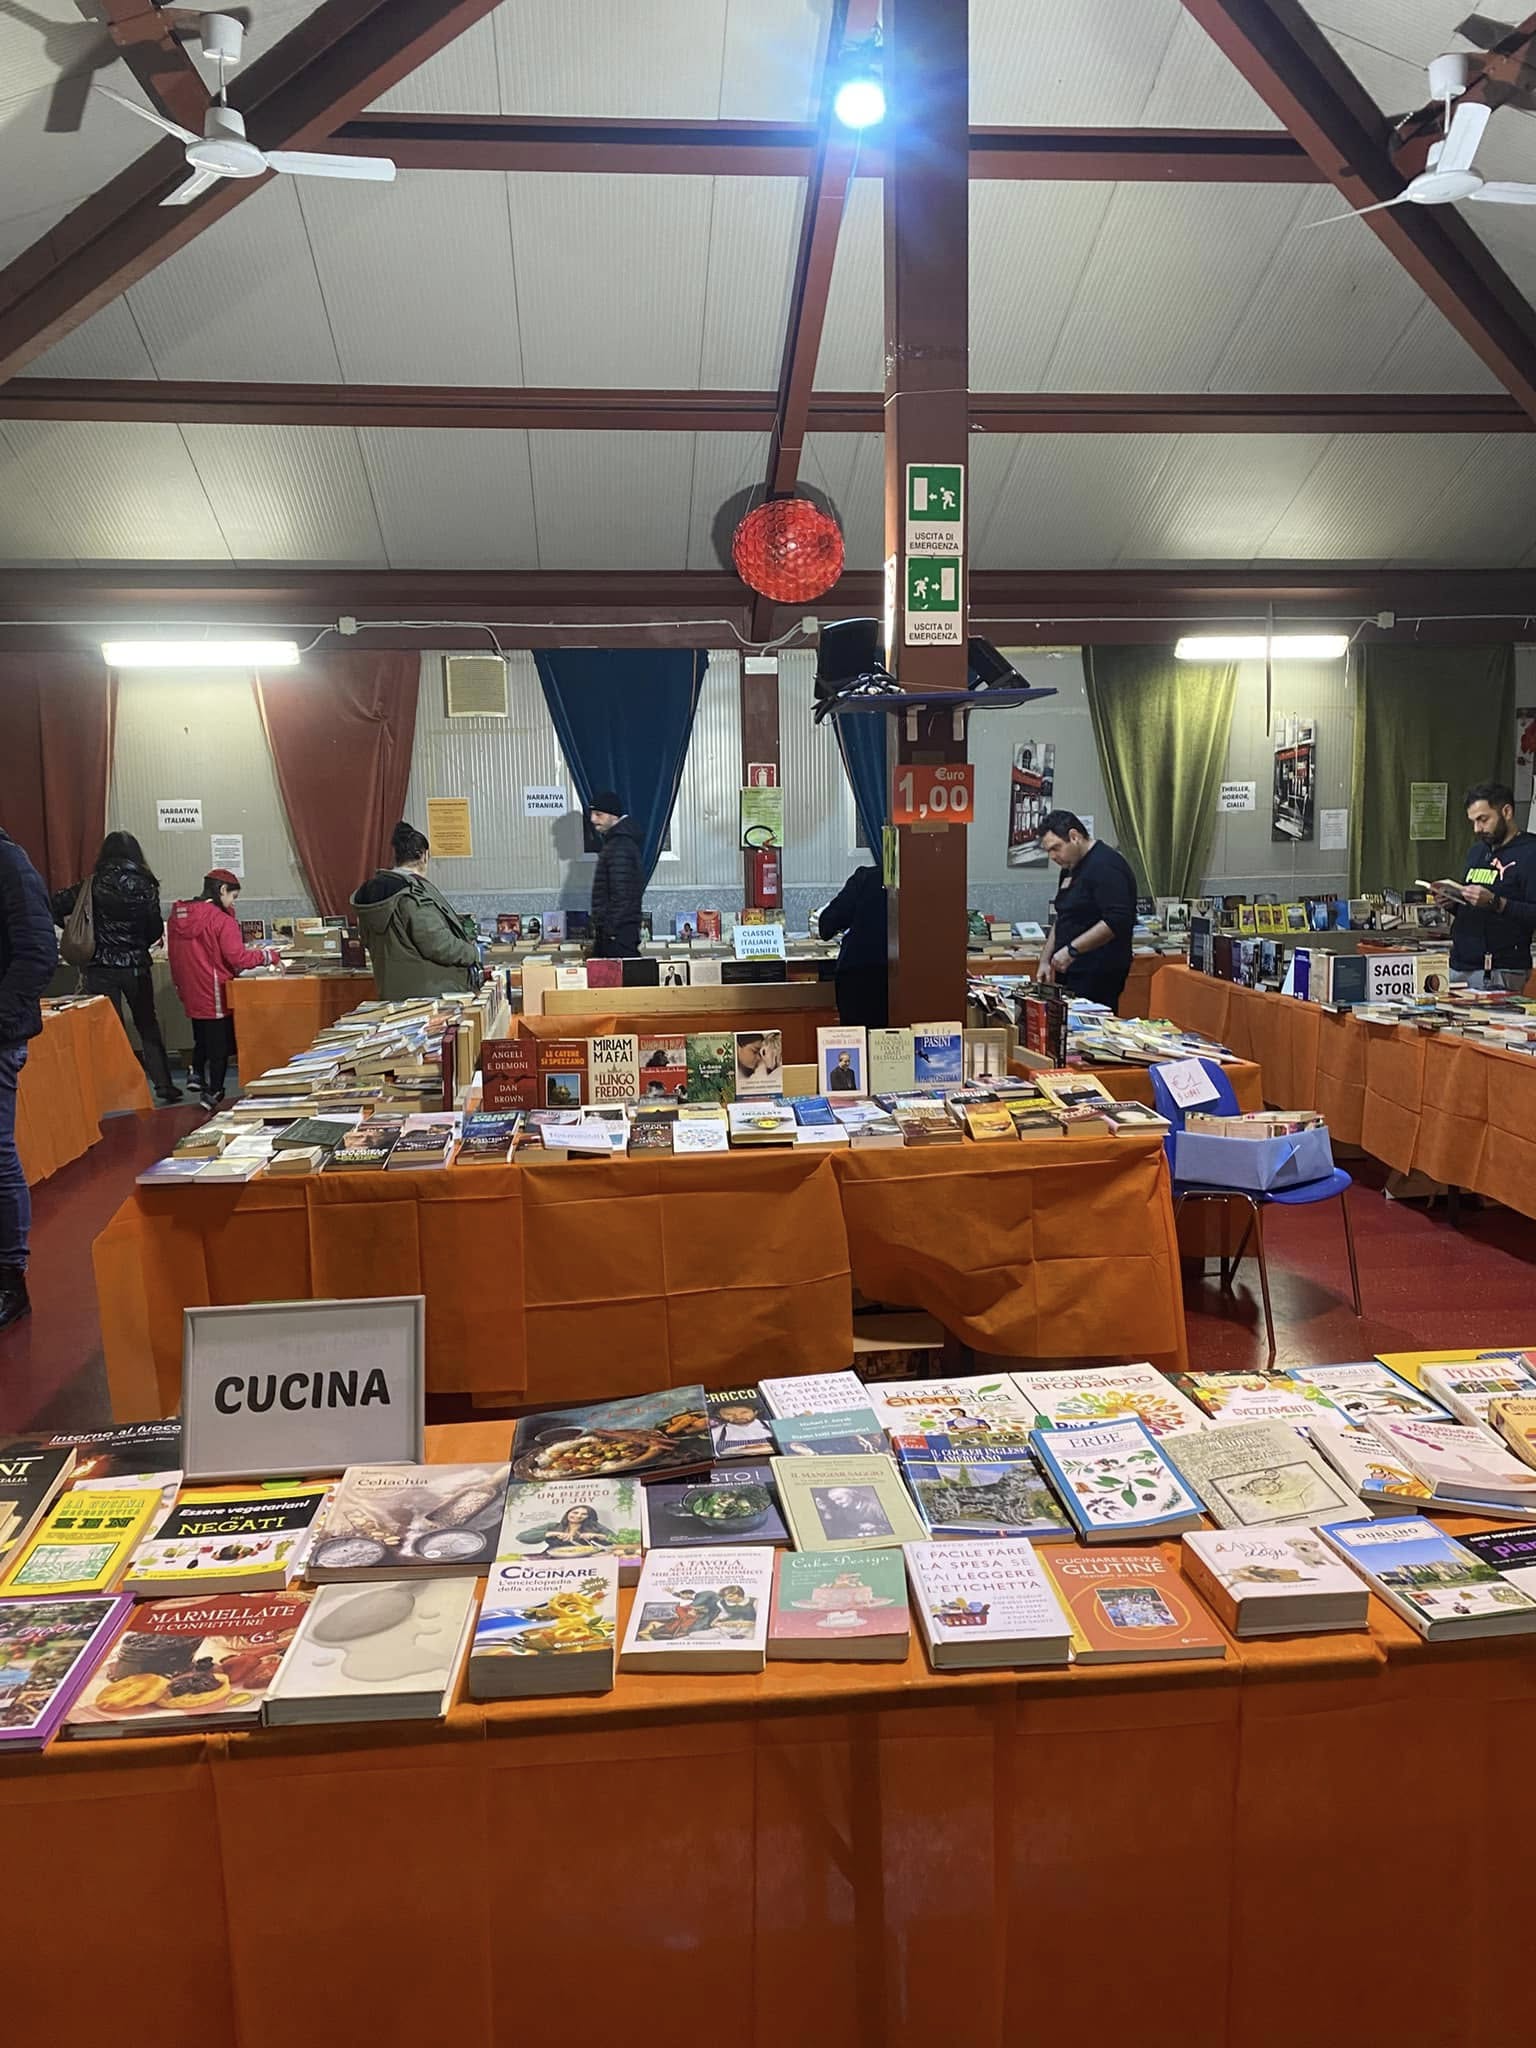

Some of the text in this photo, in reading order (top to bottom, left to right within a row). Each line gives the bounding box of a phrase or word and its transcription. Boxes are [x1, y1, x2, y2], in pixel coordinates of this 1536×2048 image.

[914, 532, 954, 542] USCITA DI
[909, 542, 959, 551] EMERGENZA
[914, 623, 953, 632] USCITA DI
[909, 632, 958, 640] EMERGENZA
[898, 772, 969, 818] 1,00
[528, 802, 564, 810] STRANIERA
[164, 816, 196, 824] ITALIANA
[1466, 868, 1498, 884] PUMA
[741, 938, 771, 946] ITALIANI
[593, 1038, 632, 1050] MIRIAM
[924, 1036, 952, 1048] PASINI
[492, 1050, 524, 1059] ANGELI
[593, 1051, 633, 1063] MAFAI
[496, 1062, 528, 1070] DEMONI
[500, 1084, 518, 1092] DAN
[595, 1086, 636, 1098] FREDDO
[494, 1096, 524, 1104] BROWN
[1444, 1366, 1515, 1380] ITALIA
[782, 1380, 820, 1388] FACILE
[824, 1376, 854, 1384] FARE
[1032, 1374, 1153, 1390] arcobaleno
[214, 1368, 391, 1415] CUCINA
[704, 1388, 758, 1403] CRACCO
[797, 1386, 835, 1394] SPESA
[883, 1387, 974, 1398] La cucina
[886, 1394, 1012, 1408] energetica
[52, 1431, 114, 1443] Intorno
[118, 1427, 134, 1436] al
[136, 1424, 182, 1433] fuoco
[1069, 1432, 1124, 1448] ERBE
[357, 1477, 429, 1487] Celiachia
[536, 1492, 554, 1500] UN
[64, 1498, 146, 1508] LA CUCINA
[178, 1499, 310, 1517] Essere vegetariani
[178, 1516, 286, 1536] NEGATI
[930, 1549, 982, 1559] FACILE
[988, 1546, 1026, 1557] FARE
[920, 1558, 1032, 1571] LA SPESA SE
[1055, 1555, 1162, 1565] CUCINARE SENZA
[500, 1566, 598, 1580] CUCINARE
[1062, 1562, 1167, 1575] GLUTINE
[922, 1569, 1037, 1582] SAI LEGGERE
[926, 1581, 1041, 1594] L'ETICHETTA
[147, 1604, 297, 1624] MARMELLATE
[154, 1618, 266, 1632] E CONFETTURE
